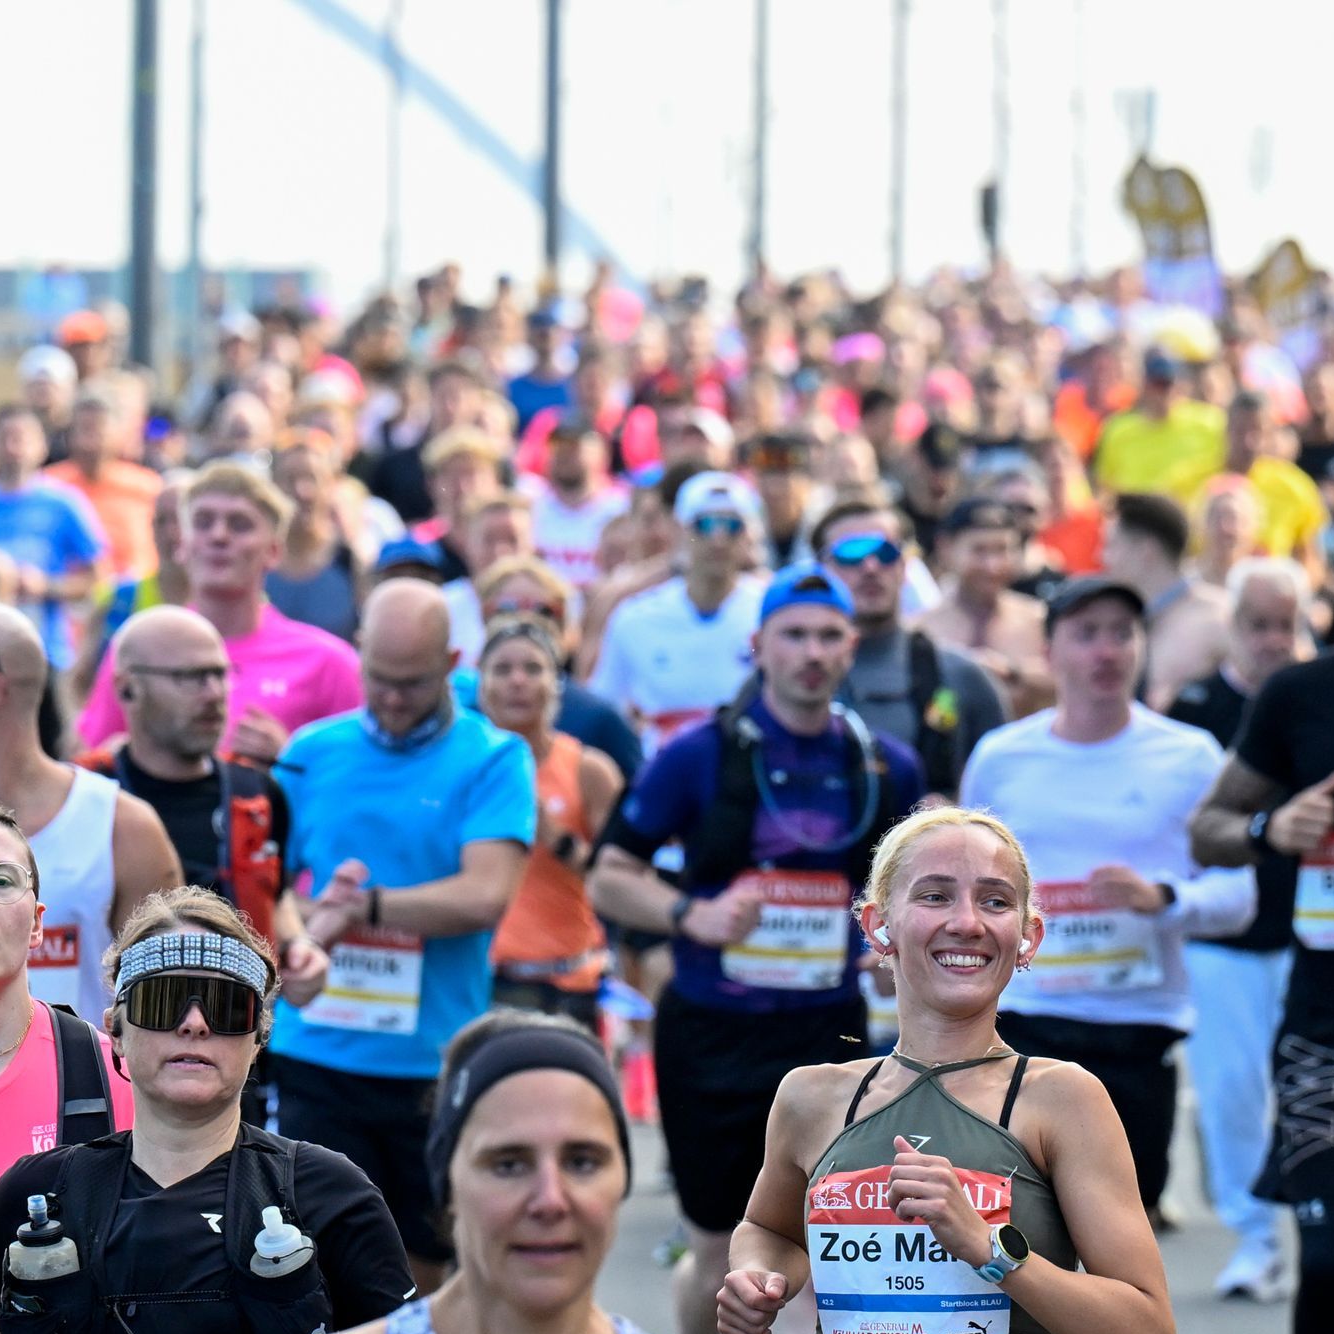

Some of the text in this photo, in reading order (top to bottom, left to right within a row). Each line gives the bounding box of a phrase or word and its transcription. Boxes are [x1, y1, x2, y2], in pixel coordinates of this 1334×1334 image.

[855, 1182, 1003, 1211] GEALI
[820, 1231, 882, 1262] Zoé
[885, 1276, 925, 1291] 1505
[940, 1300, 979, 1308] Startblock
[870, 1323, 909, 1331] GENERALI
